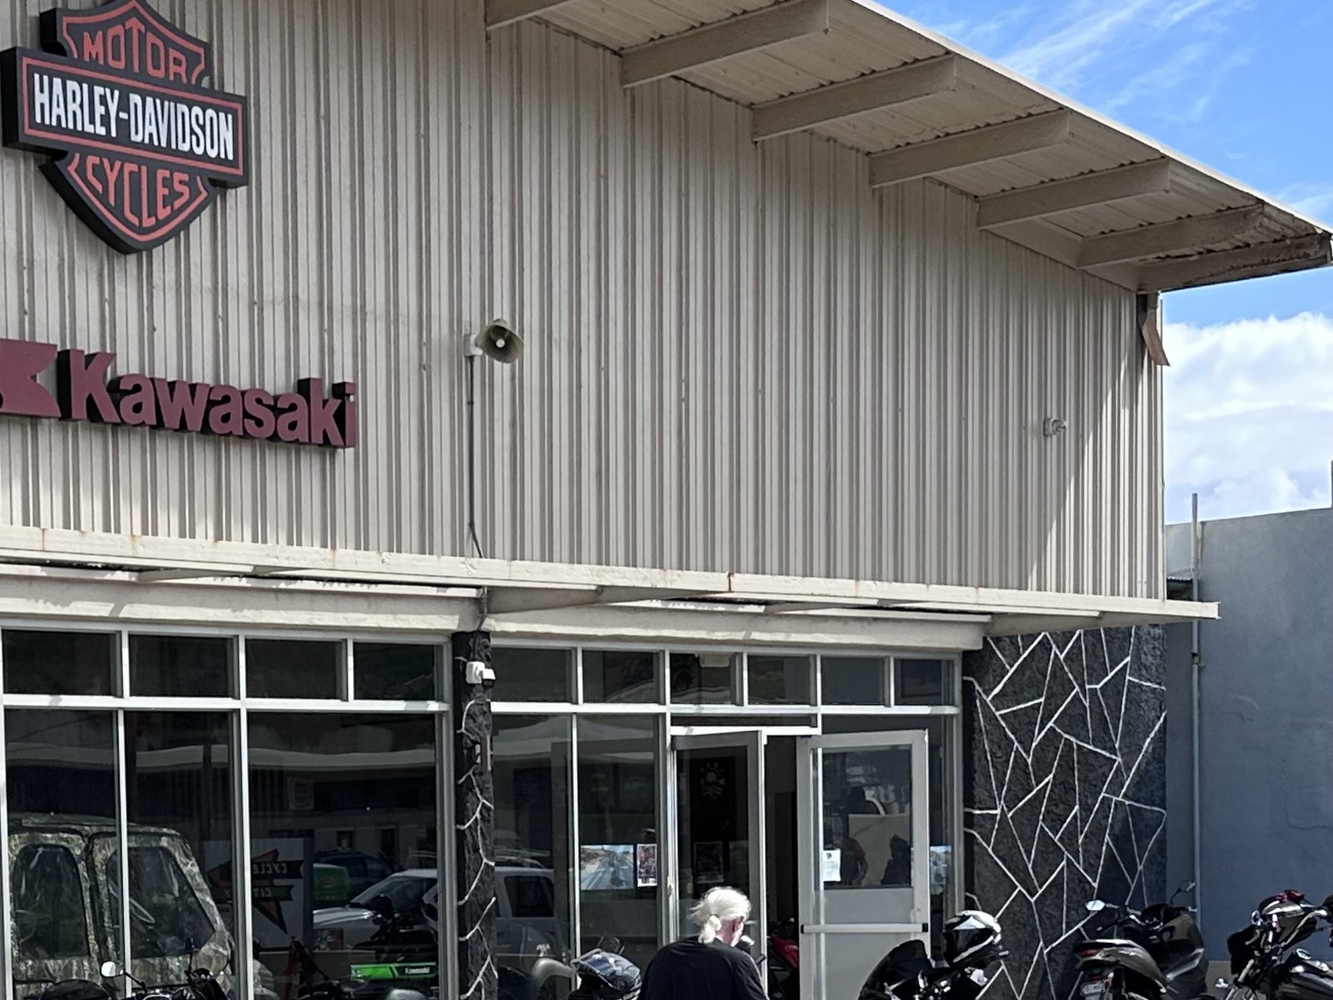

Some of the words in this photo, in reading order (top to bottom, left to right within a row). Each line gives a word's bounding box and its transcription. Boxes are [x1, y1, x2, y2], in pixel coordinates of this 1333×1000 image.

[83, 17, 188, 82] MOTOR
[33, 73, 234, 160] HARLEY-DAVIDSON
[86, 155, 190, 228] CYCLES
[67, 350, 356, 447] Kawasaki
